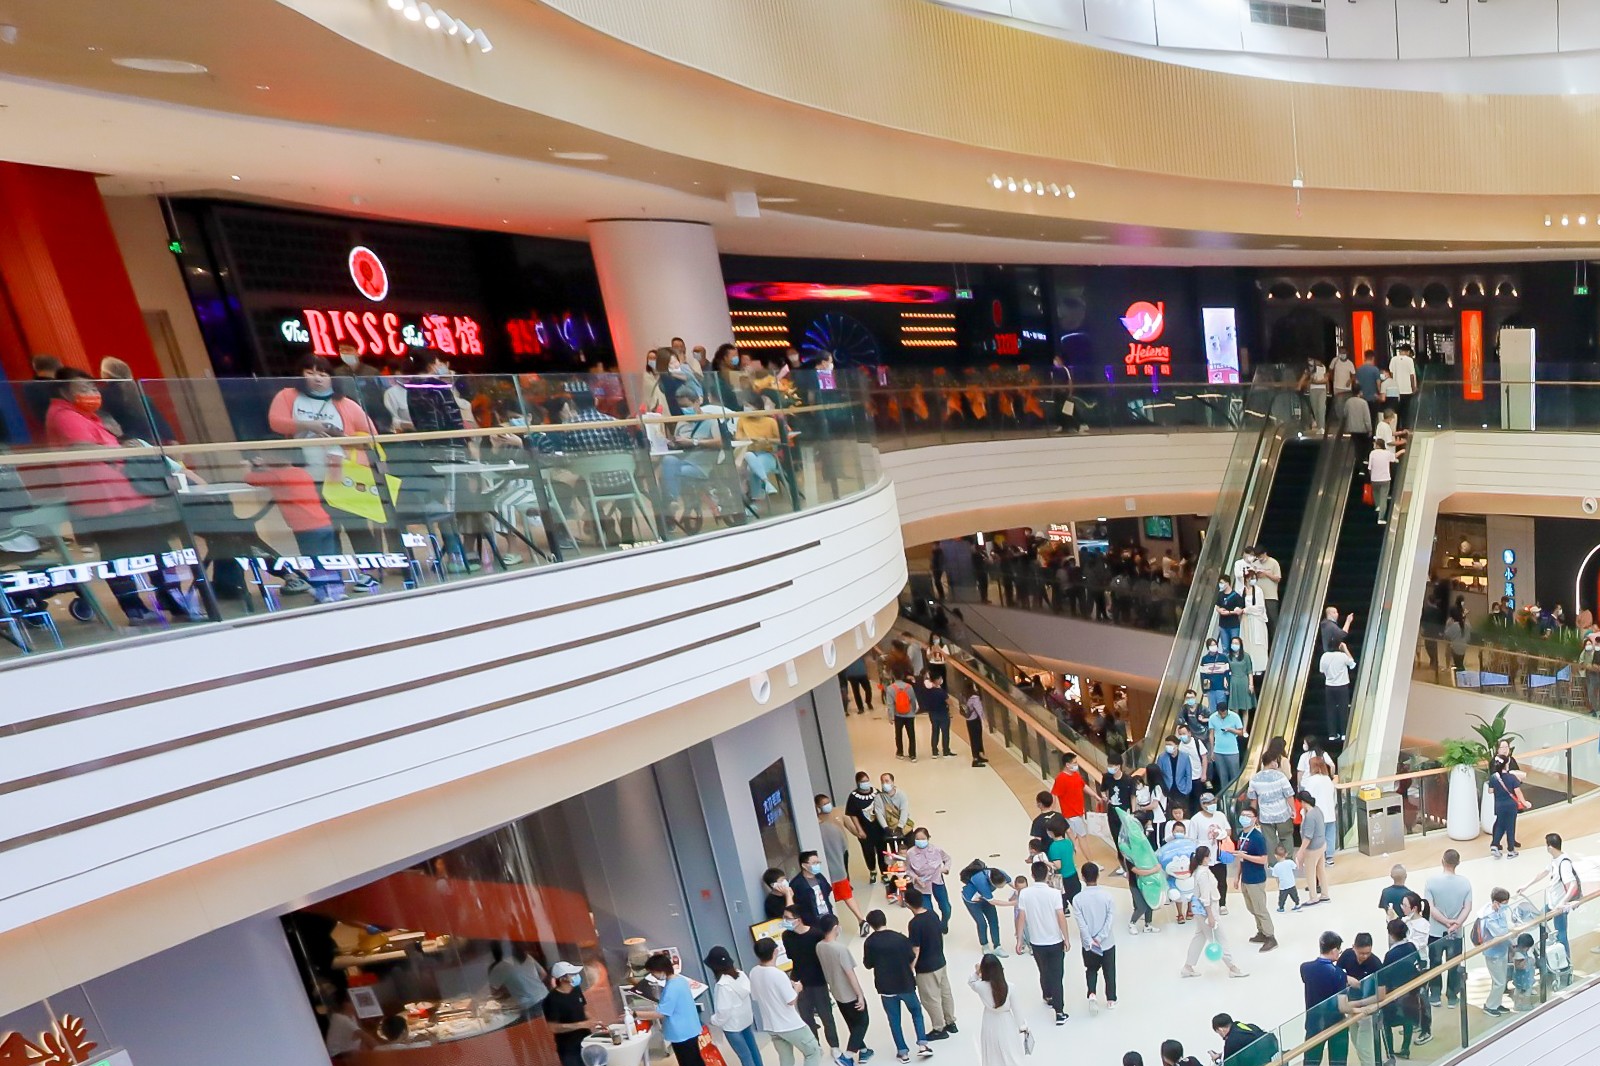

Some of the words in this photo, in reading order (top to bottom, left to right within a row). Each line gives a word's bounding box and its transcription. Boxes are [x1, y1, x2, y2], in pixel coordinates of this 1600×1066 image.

[280, 319, 310, 343] The
[422, 314, 485, 356] 酒馆
[1125, 342, 1172, 364] Helen's
